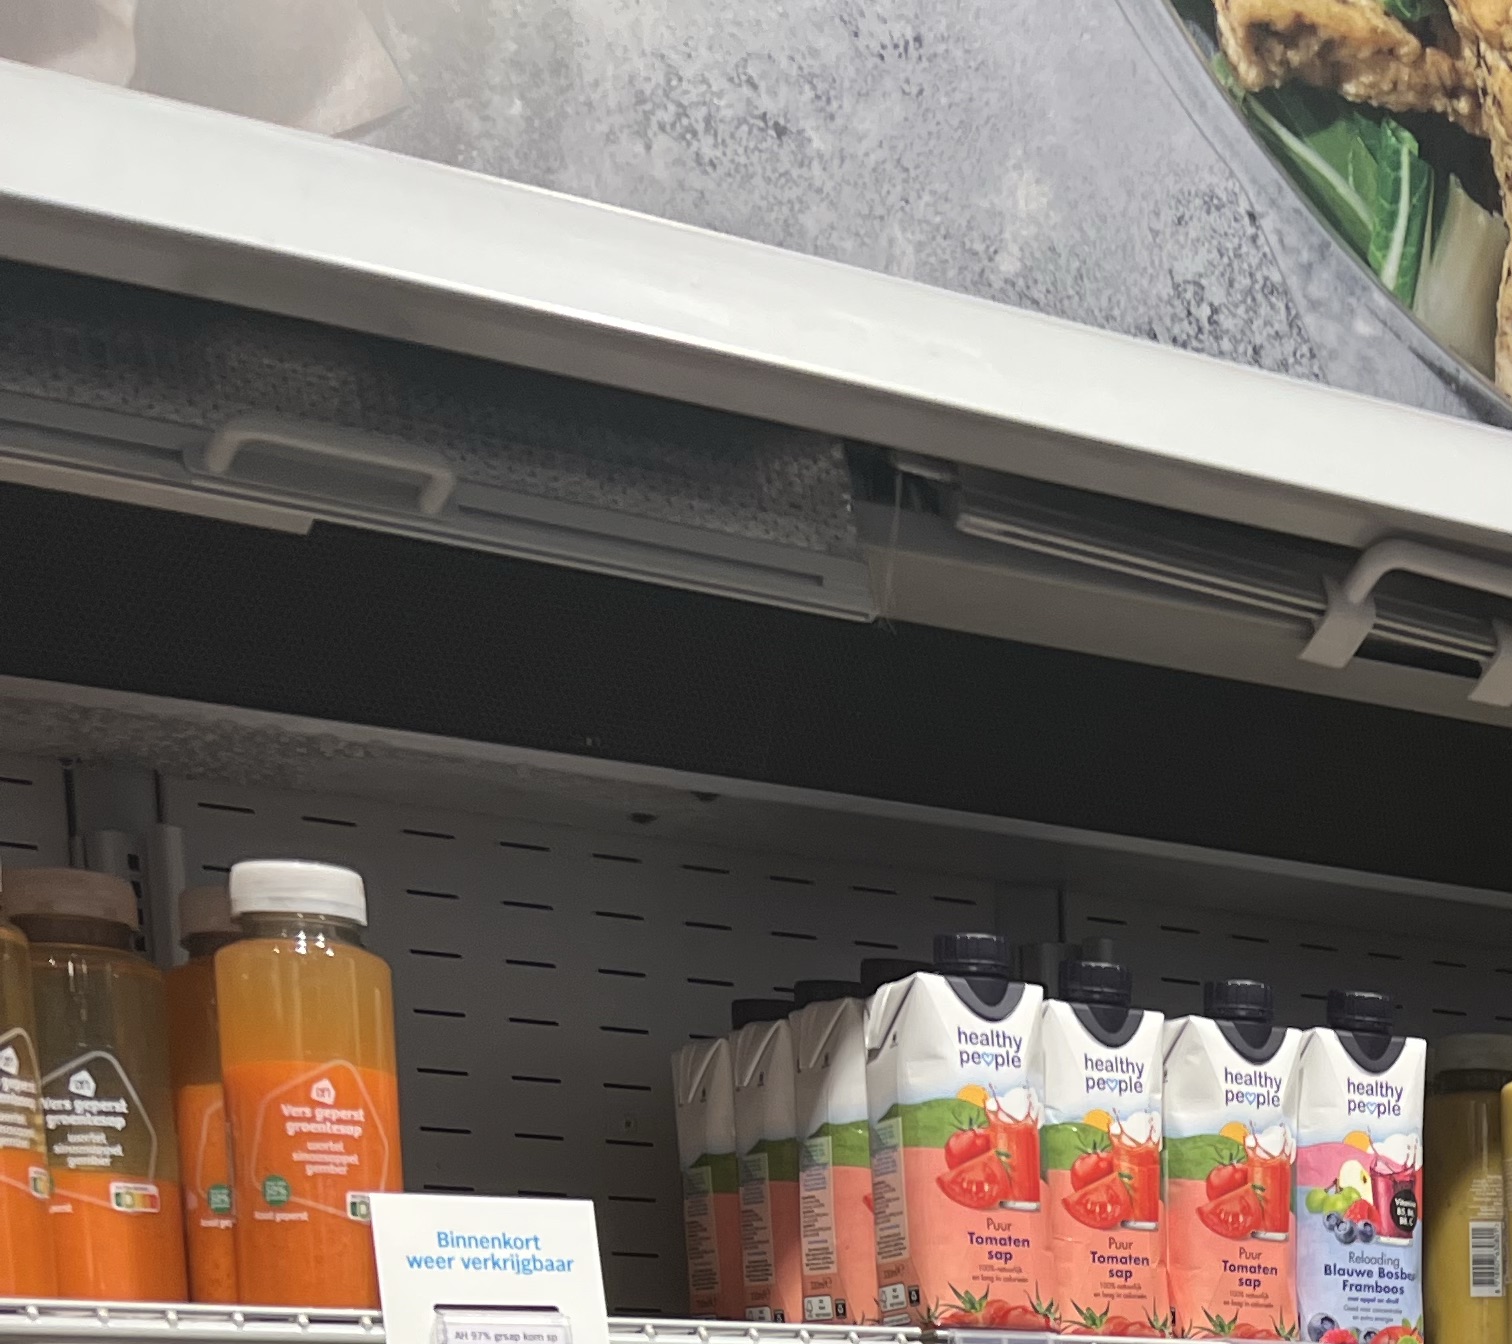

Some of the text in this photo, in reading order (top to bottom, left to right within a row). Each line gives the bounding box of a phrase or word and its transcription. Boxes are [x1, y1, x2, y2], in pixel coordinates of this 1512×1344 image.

[957, 1026, 1022, 1053] healthy
[1347, 1079, 1403, 1102] healthy
[986, 1218, 1011, 1231] Puur
[436, 1231, 542, 1251] Binnenkort
[968, 1232, 1030, 1248] Tomaten
[406, 1253, 574, 1275] weer verkrijgbaar
[987, 1249, 1013, 1264] sap
[1348, 1252, 1400, 1268] Reloading
[1324, 1264, 1380, 1278] Blauwe
[1342, 1280, 1405, 1295] Framboos
